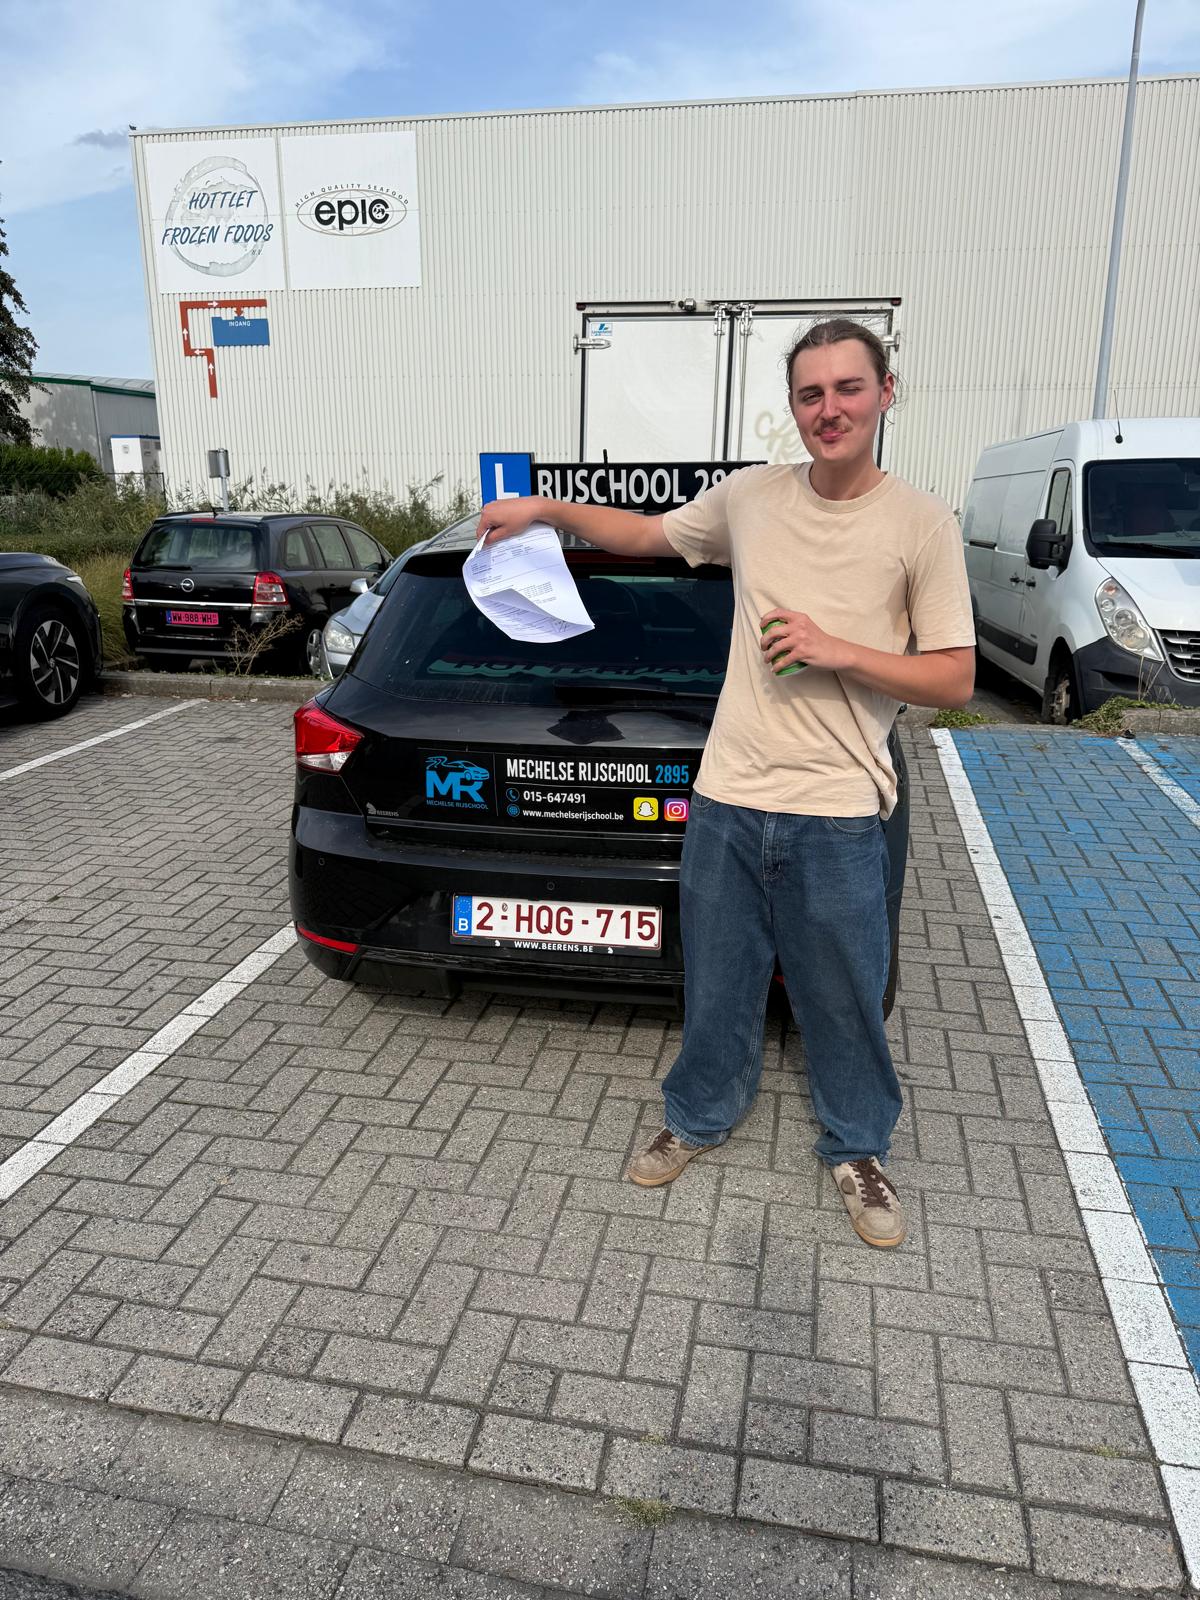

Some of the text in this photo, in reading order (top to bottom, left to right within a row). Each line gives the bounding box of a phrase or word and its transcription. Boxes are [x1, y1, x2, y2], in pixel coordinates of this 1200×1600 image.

[188, 190, 258, 210] HOTTLET
[295, 183, 409, 208] HIGH QUALITY SEAFOOD
[314, 198, 390, 231] epic
[161, 223, 274, 245] FROZEN FOODS
[494, 463, 520, 500] L
[537, 468, 687, 504] RIJSCHOOL
[506, 758, 690, 784] MECHELSE RIJSCHOOL 2895
[425, 770, 485, 803] MR
[523, 790, 586, 804] 015-647491
[426, 799, 489, 810] MECHELSE RIJSCHOOL
[522, 807, 624, 822] www.mechelserijschool.be
[458, 917, 469, 932] B
[476, 901, 657, 941] 2-HQG-715
[514, 940, 594, 954] WWW.BEERENS.BE
